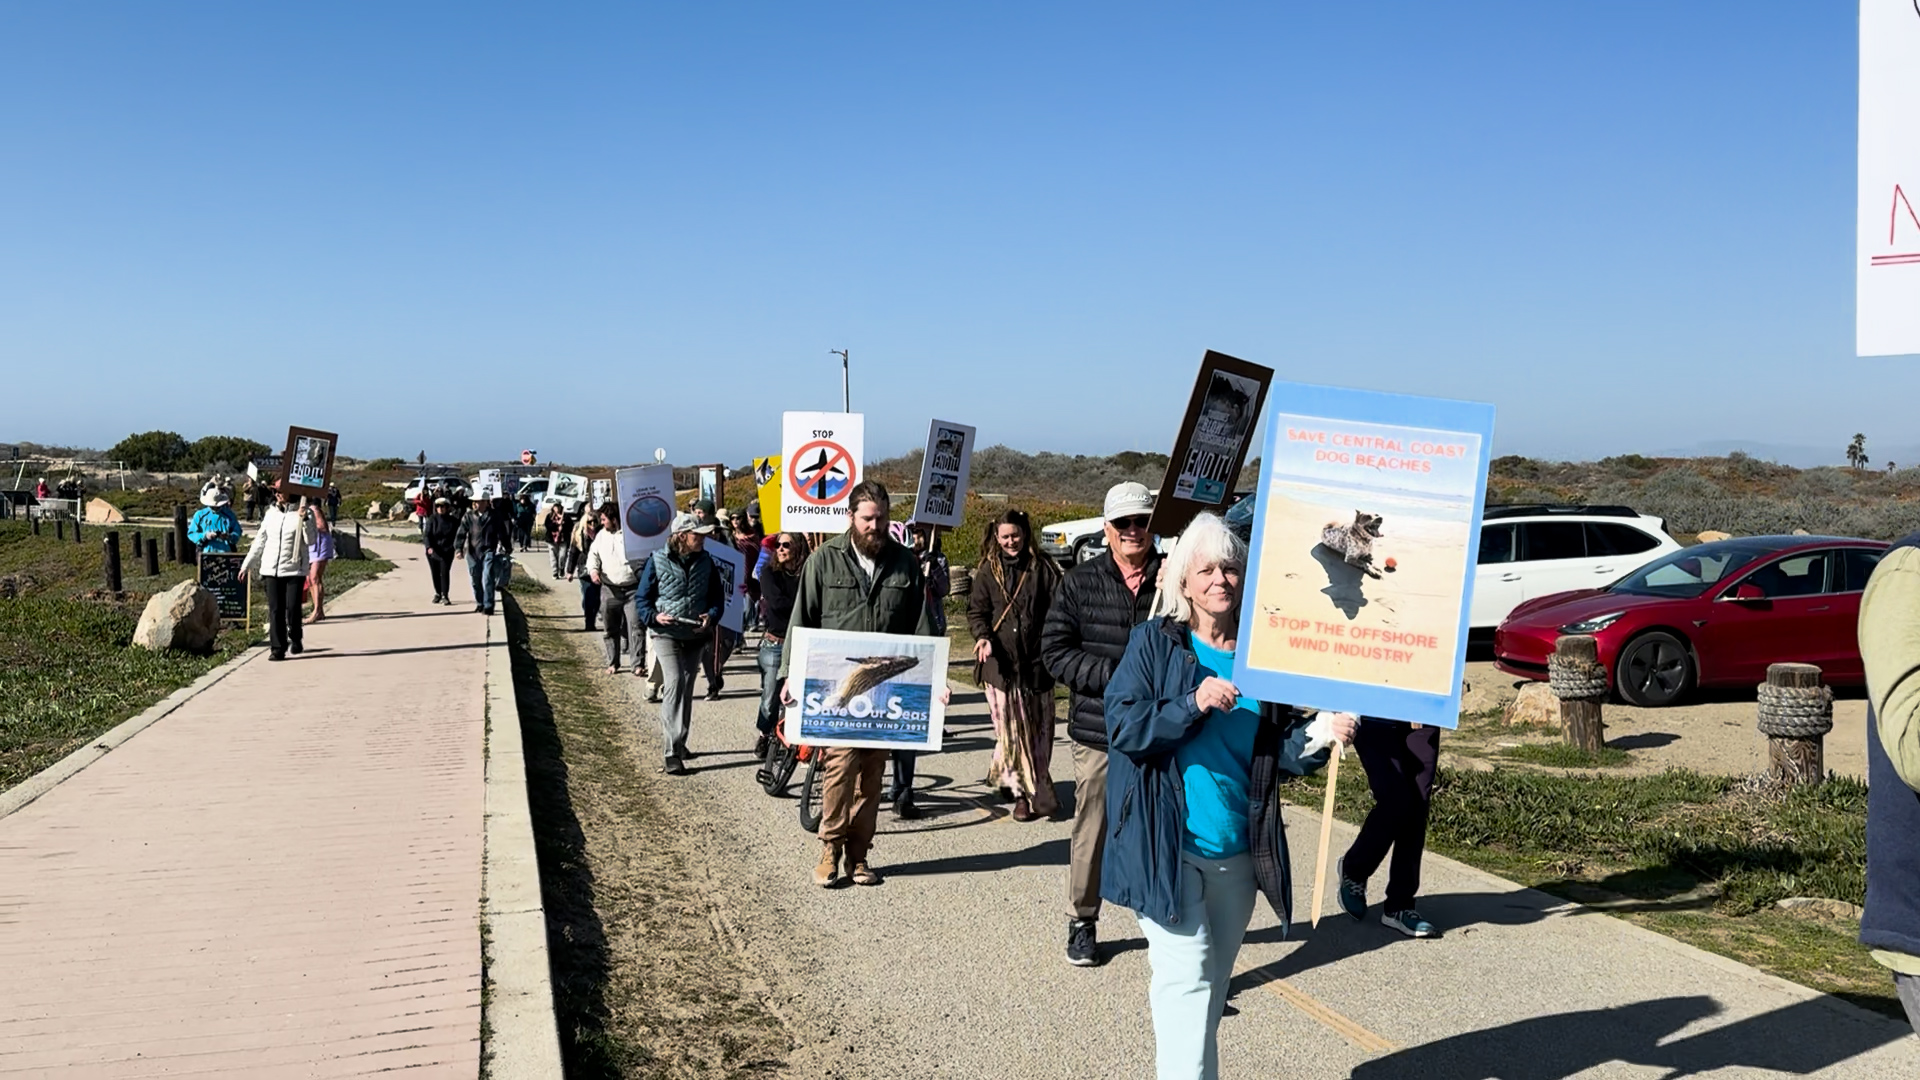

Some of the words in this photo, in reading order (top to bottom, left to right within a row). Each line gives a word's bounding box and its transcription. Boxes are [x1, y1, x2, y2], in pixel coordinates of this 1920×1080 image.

[812, 430, 833, 438] STOP
[1288, 429, 1326, 444] SAVE
[1332, 433, 1405, 452] CENTRAL
[1410, 442, 1466, 458] COAST
[293, 463, 310, 476] END
[311, 467, 323, 479] IT!
[1185, 449, 1216, 479] END
[1211, 454, 1233, 482] IT!
[1315, 450, 1350, 464] DOG
[1355, 454, 1431, 473] BEACHES
[787, 506, 830, 515] OFFSHORE
[833, 507, 849, 515] WIN
[1269, 615, 1310, 632] STOP
[1315, 621, 1345, 636] THE
[1350, 626, 1438, 649] OFFSHORE
[1289, 636, 1329, 652] WIND
[1334, 642, 1413, 664] INDUSTRY
[805, 692, 847, 716] Save
[848, 695, 886, 718] Our
[887, 696, 927, 720] Seas
[828, 720, 872, 728] OFFSHORE
